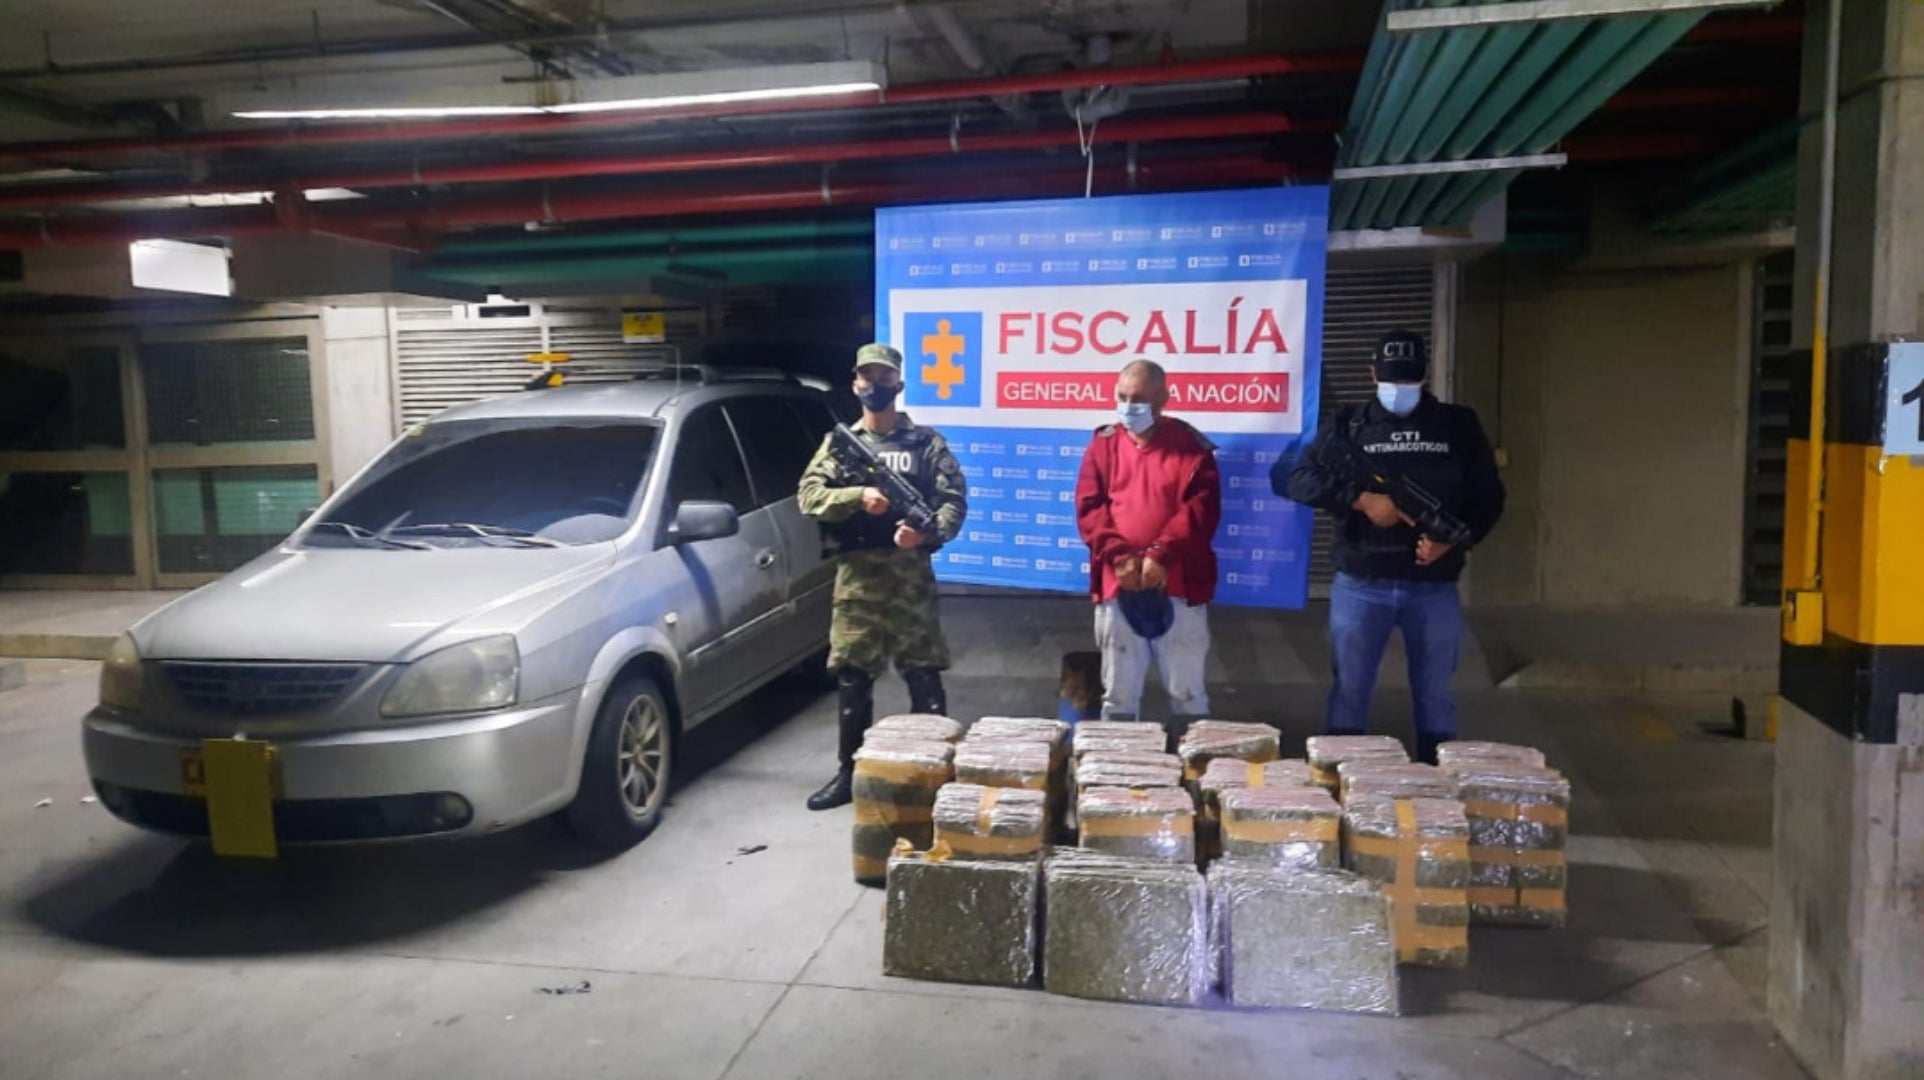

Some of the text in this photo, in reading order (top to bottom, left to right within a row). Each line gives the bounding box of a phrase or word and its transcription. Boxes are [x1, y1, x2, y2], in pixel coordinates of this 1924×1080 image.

[998, 296, 1288, 355] FISCALÍA
[1384, 341, 1415, 356] CTI
[1003, 381, 1108, 402] GENERAL
[1168, 382, 1182, 402] A
[1187, 376, 1281, 404] NACIÓN
[1391, 431, 1420, 441] CTI
